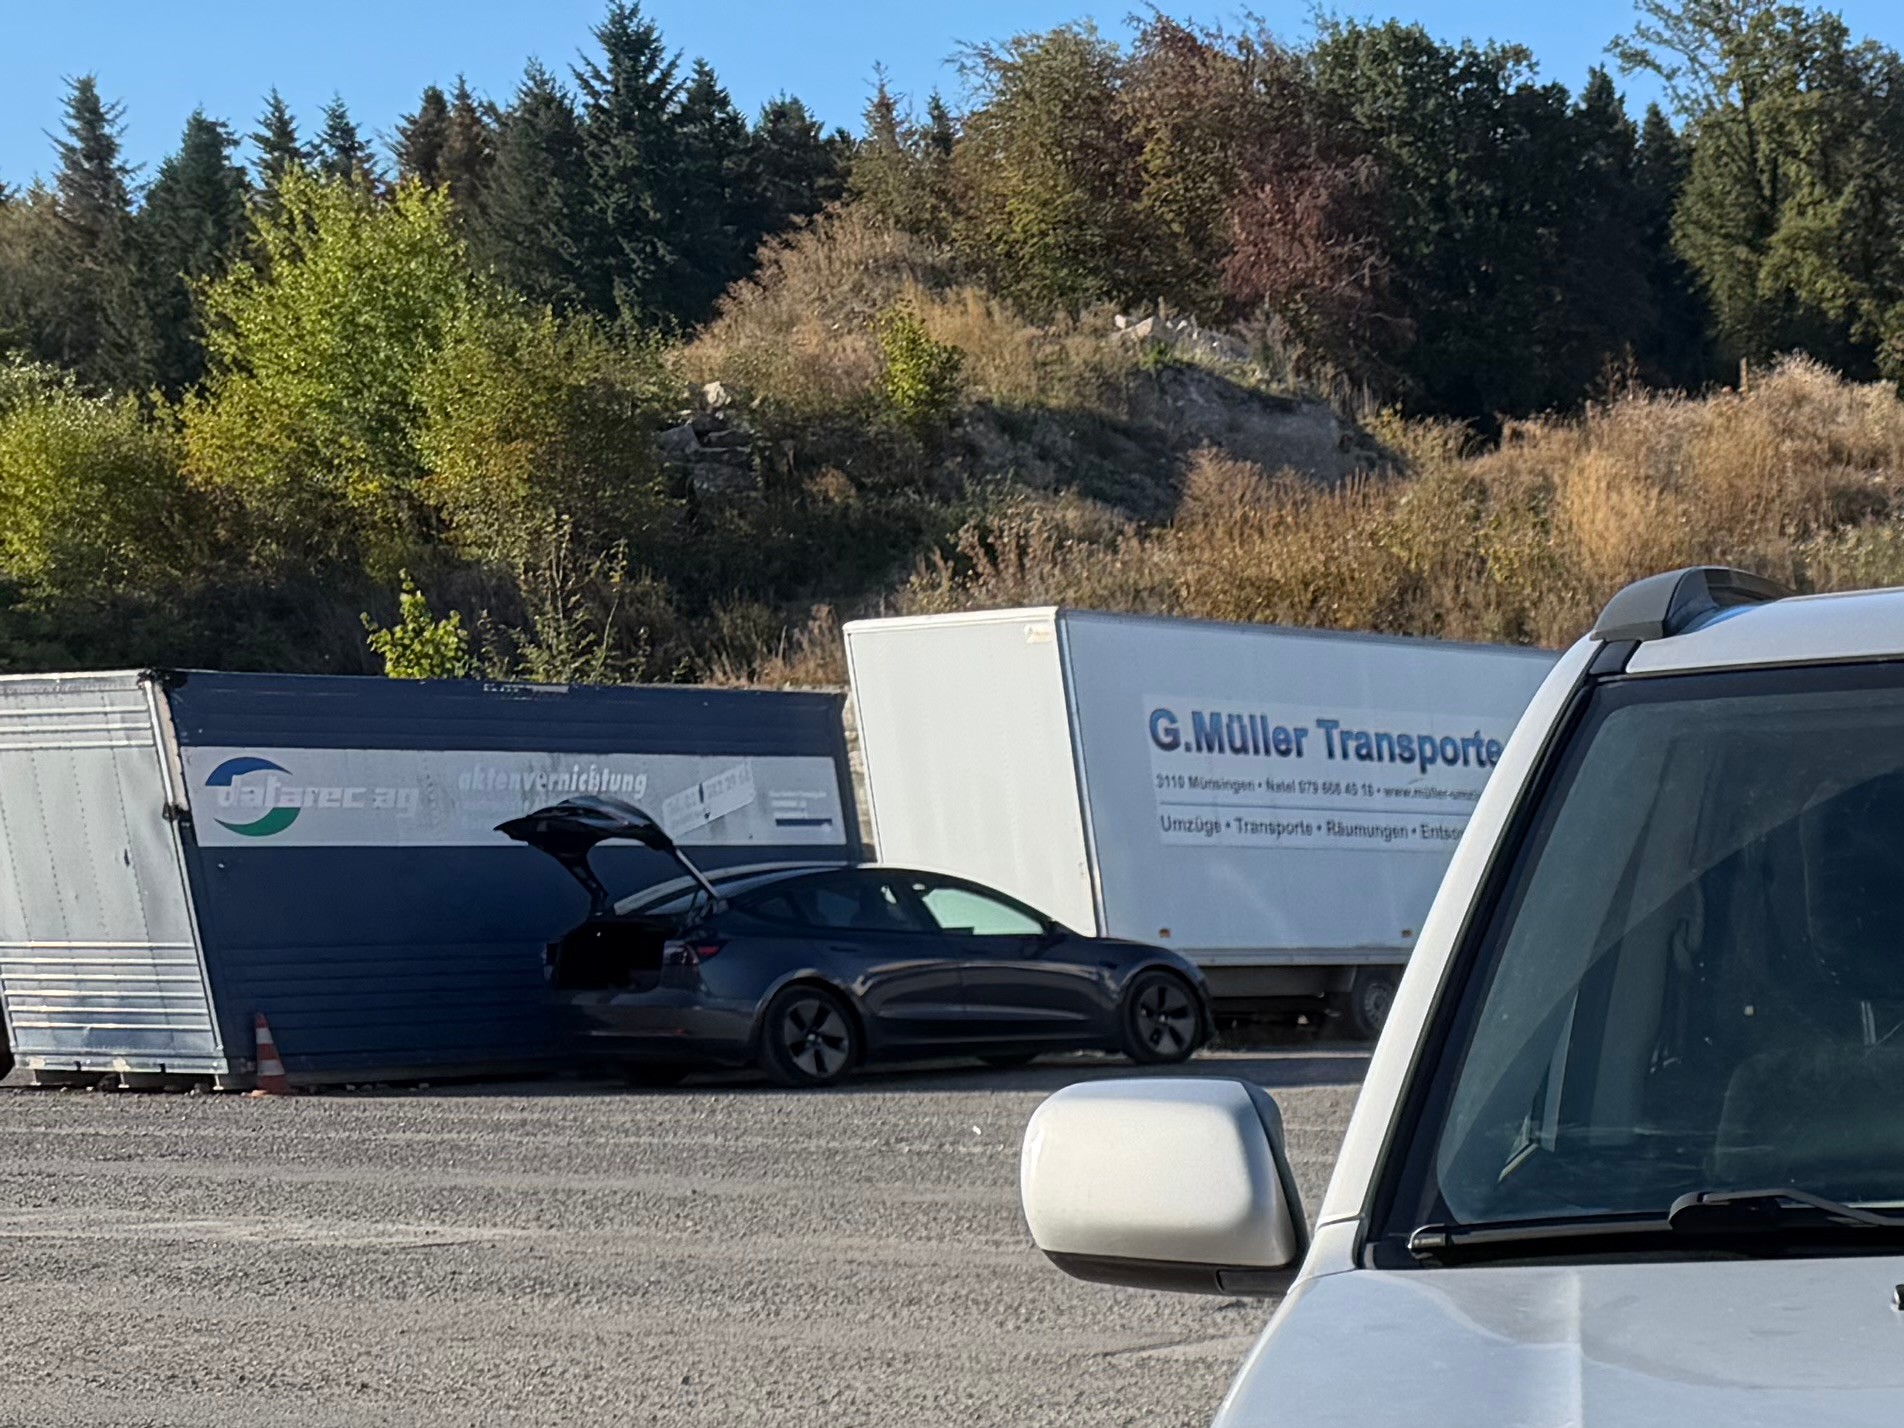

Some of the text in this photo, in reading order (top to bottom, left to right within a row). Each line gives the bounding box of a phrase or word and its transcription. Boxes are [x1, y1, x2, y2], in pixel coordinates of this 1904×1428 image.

[1149, 708, 1505, 775] G.Müller Transporte
[458, 764, 648, 799] aktenvernichtung
[1160, 815, 1222, 837] Umzüge
[1235, 817, 1313, 841] Transporte
[1326, 820, 1409, 843] Räumungen
